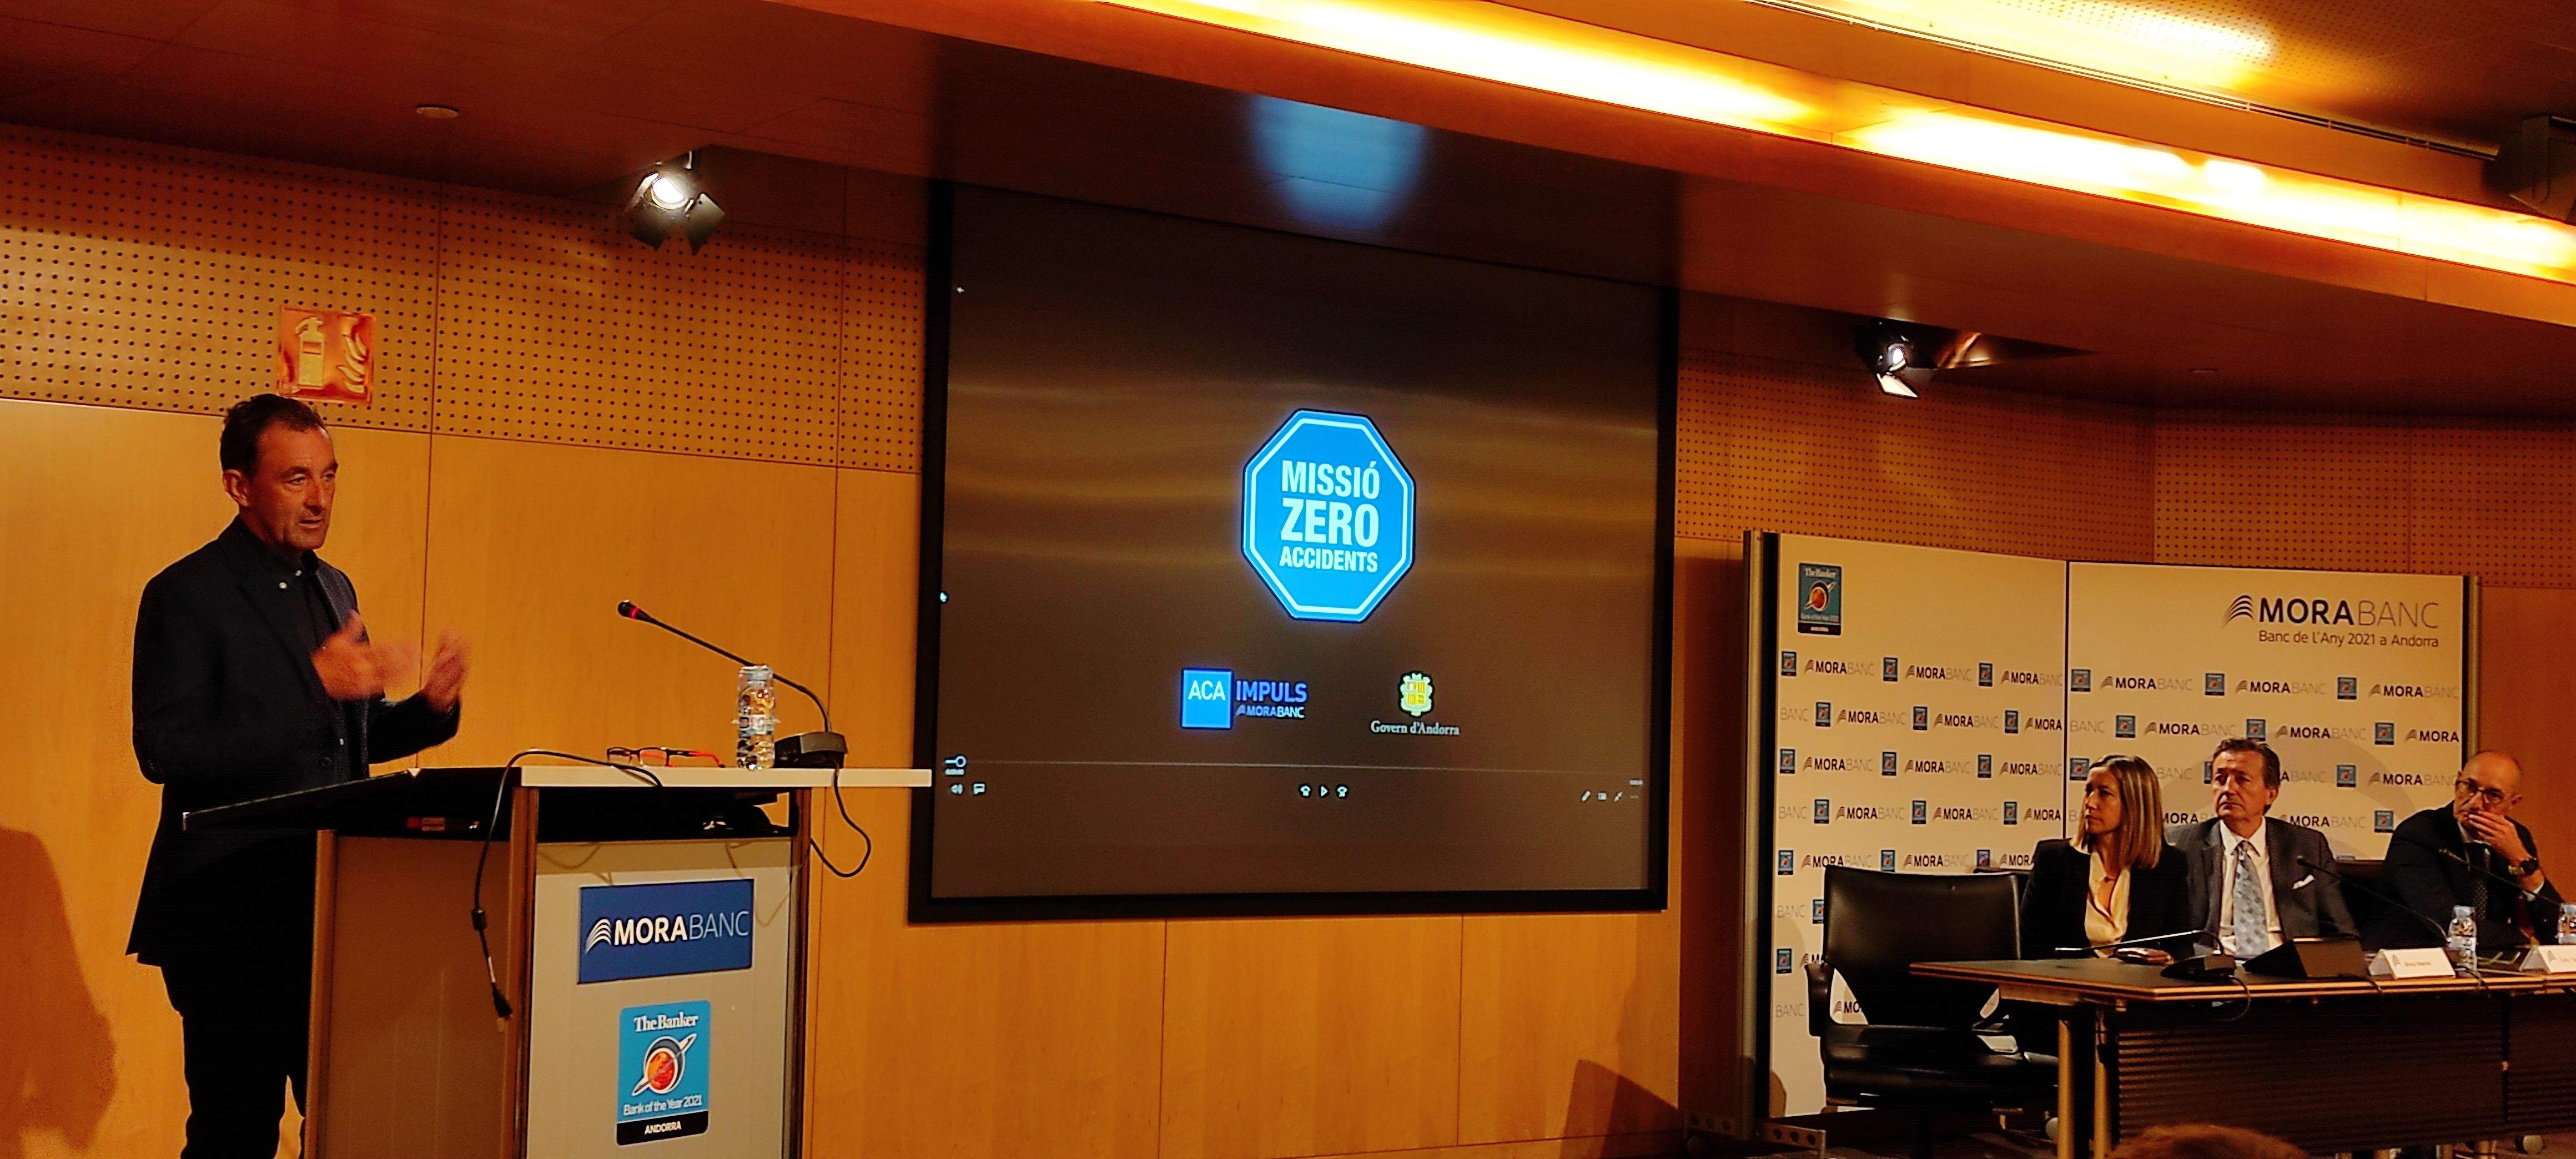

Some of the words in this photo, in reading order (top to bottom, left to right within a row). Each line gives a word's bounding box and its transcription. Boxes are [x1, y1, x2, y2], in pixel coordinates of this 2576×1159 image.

[1281, 460, 1380, 499] MISSIÓ
[1281, 497, 1378, 547] ZERO
[1279, 546, 1378, 573] ACCIDENTS
[2259, 597, 2438, 628] MORABANC
[2259, 631, 2289, 642] Banc
[2294, 631, 2308, 643] de
[2347, 633, 2374, 645] 2021
[2380, 637, 2387, 646] a
[2391, 634, 2438, 647] Andorra
[1188, 679, 1226, 701] ACA
[1236, 681, 1307, 703] IMPULS
[1246, 705, 1305, 718] MORABANC
[1371, 720, 1407, 733] Govern
[1410, 722, 1460, 735] d'Andorra
[614, 911, 749, 945] MORABANC
[633, 1015, 657, 1032] The
[657, 1012, 698, 1029] Banker
[623, 1102, 645, 1116] Bank
[645, 1101, 654, 1112] of
[653, 1101, 667, 1112] the
[667, 1099, 684, 1109] Year
[683, 1095, 702, 1107] 2021
[645, 1121, 682, 1134] ANDORRA
